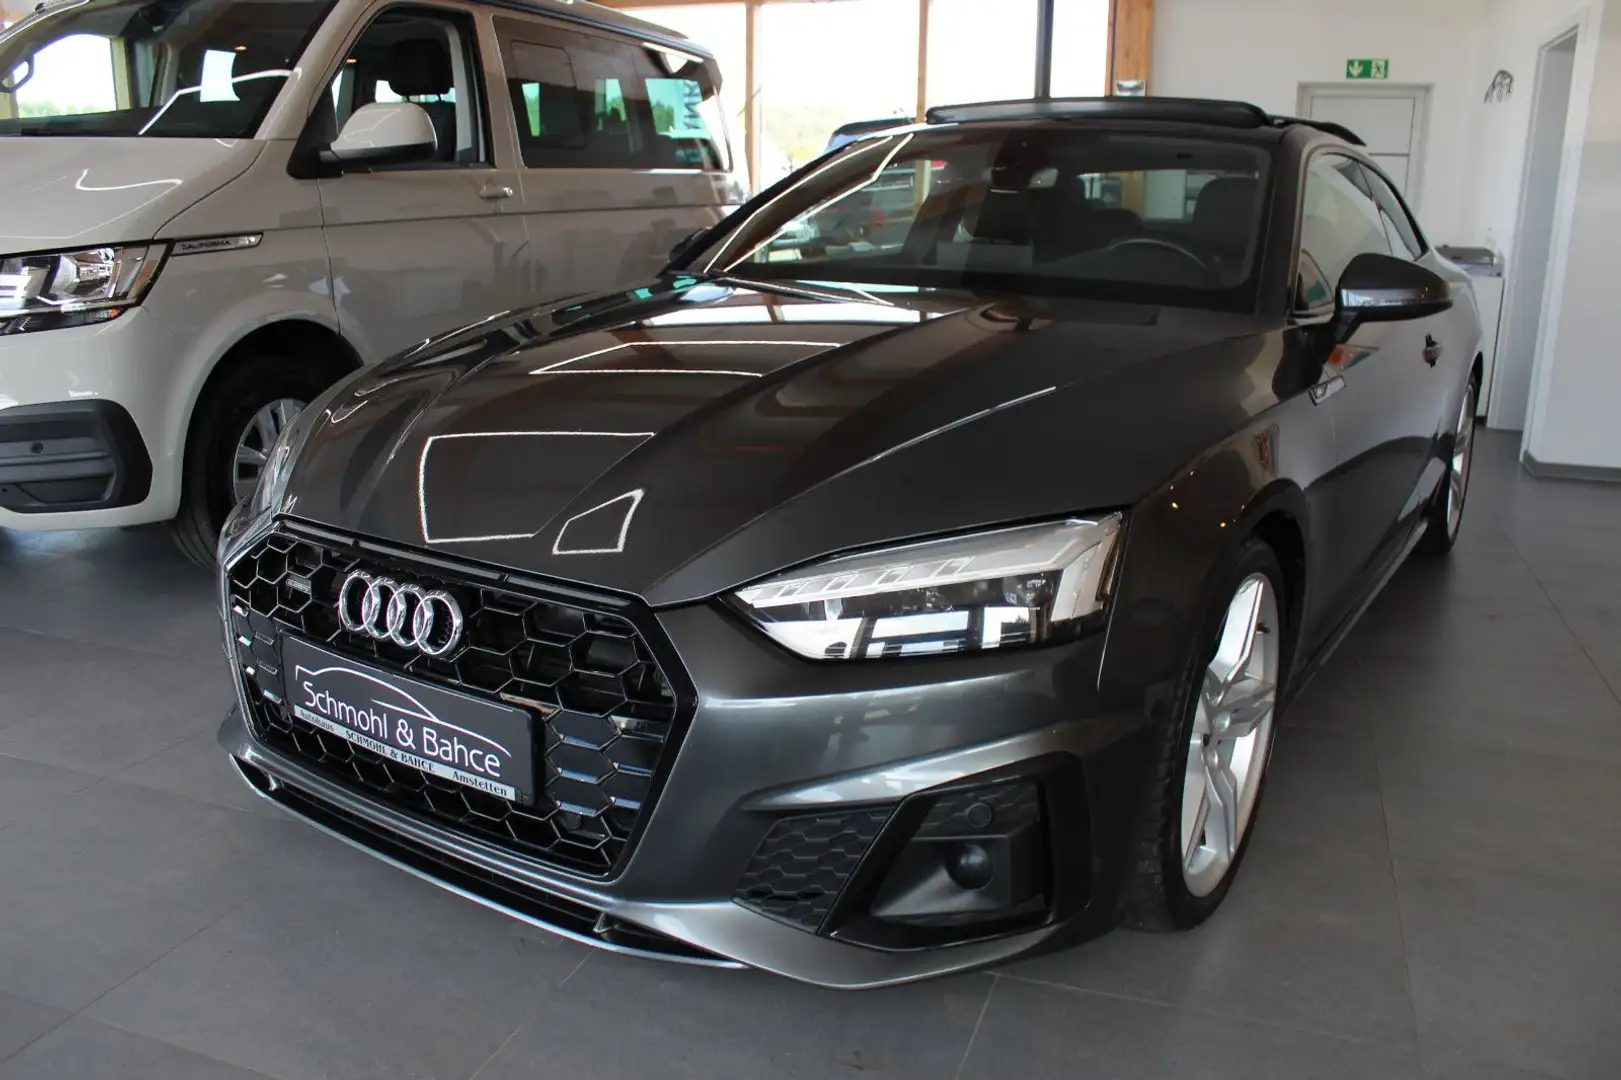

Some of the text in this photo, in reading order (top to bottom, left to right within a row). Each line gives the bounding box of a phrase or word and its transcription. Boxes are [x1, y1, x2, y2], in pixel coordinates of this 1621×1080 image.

[300, 709, 508, 797] Autohaus SCHMOHL & BAHCE Amstetten
[303, 680, 501, 778] Schmohl & Bahce
